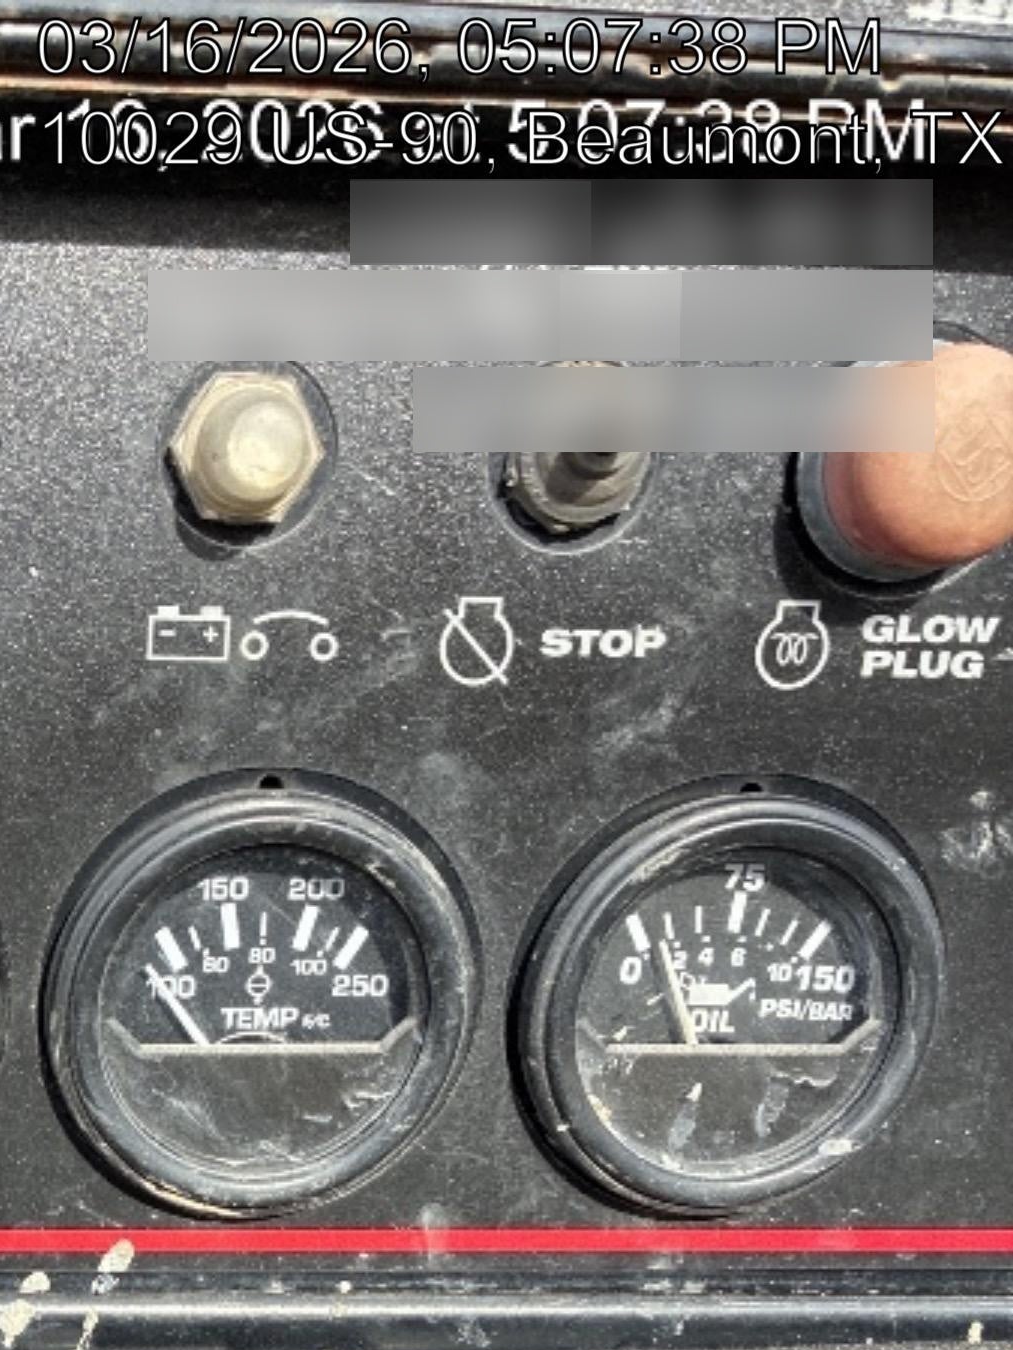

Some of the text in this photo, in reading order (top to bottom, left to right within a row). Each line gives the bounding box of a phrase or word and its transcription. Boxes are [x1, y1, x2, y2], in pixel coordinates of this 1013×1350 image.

[861, 613, 1002, 645] GLOW
[539, 628, 668, 659] STOP
[860, 649, 986, 680] PLUG
[196, 876, 250, 901] 150
[287, 876, 345, 901] 200
[724, 863, 766, 892] 75
[248, 947, 276, 965] 80
[291, 959, 328, 976] 100
[697, 946, 715, 967] 4
[618, 956, 643, 985] 0
[766, 963, 793, 983] 10
[793, 964, 856, 993] 150
[331, 974, 390, 998] 250
[220, 1006, 300, 1031] TEMP
[689, 1010, 736, 1034] OIL
[758, 998, 853, 1023] PSI/BAR
